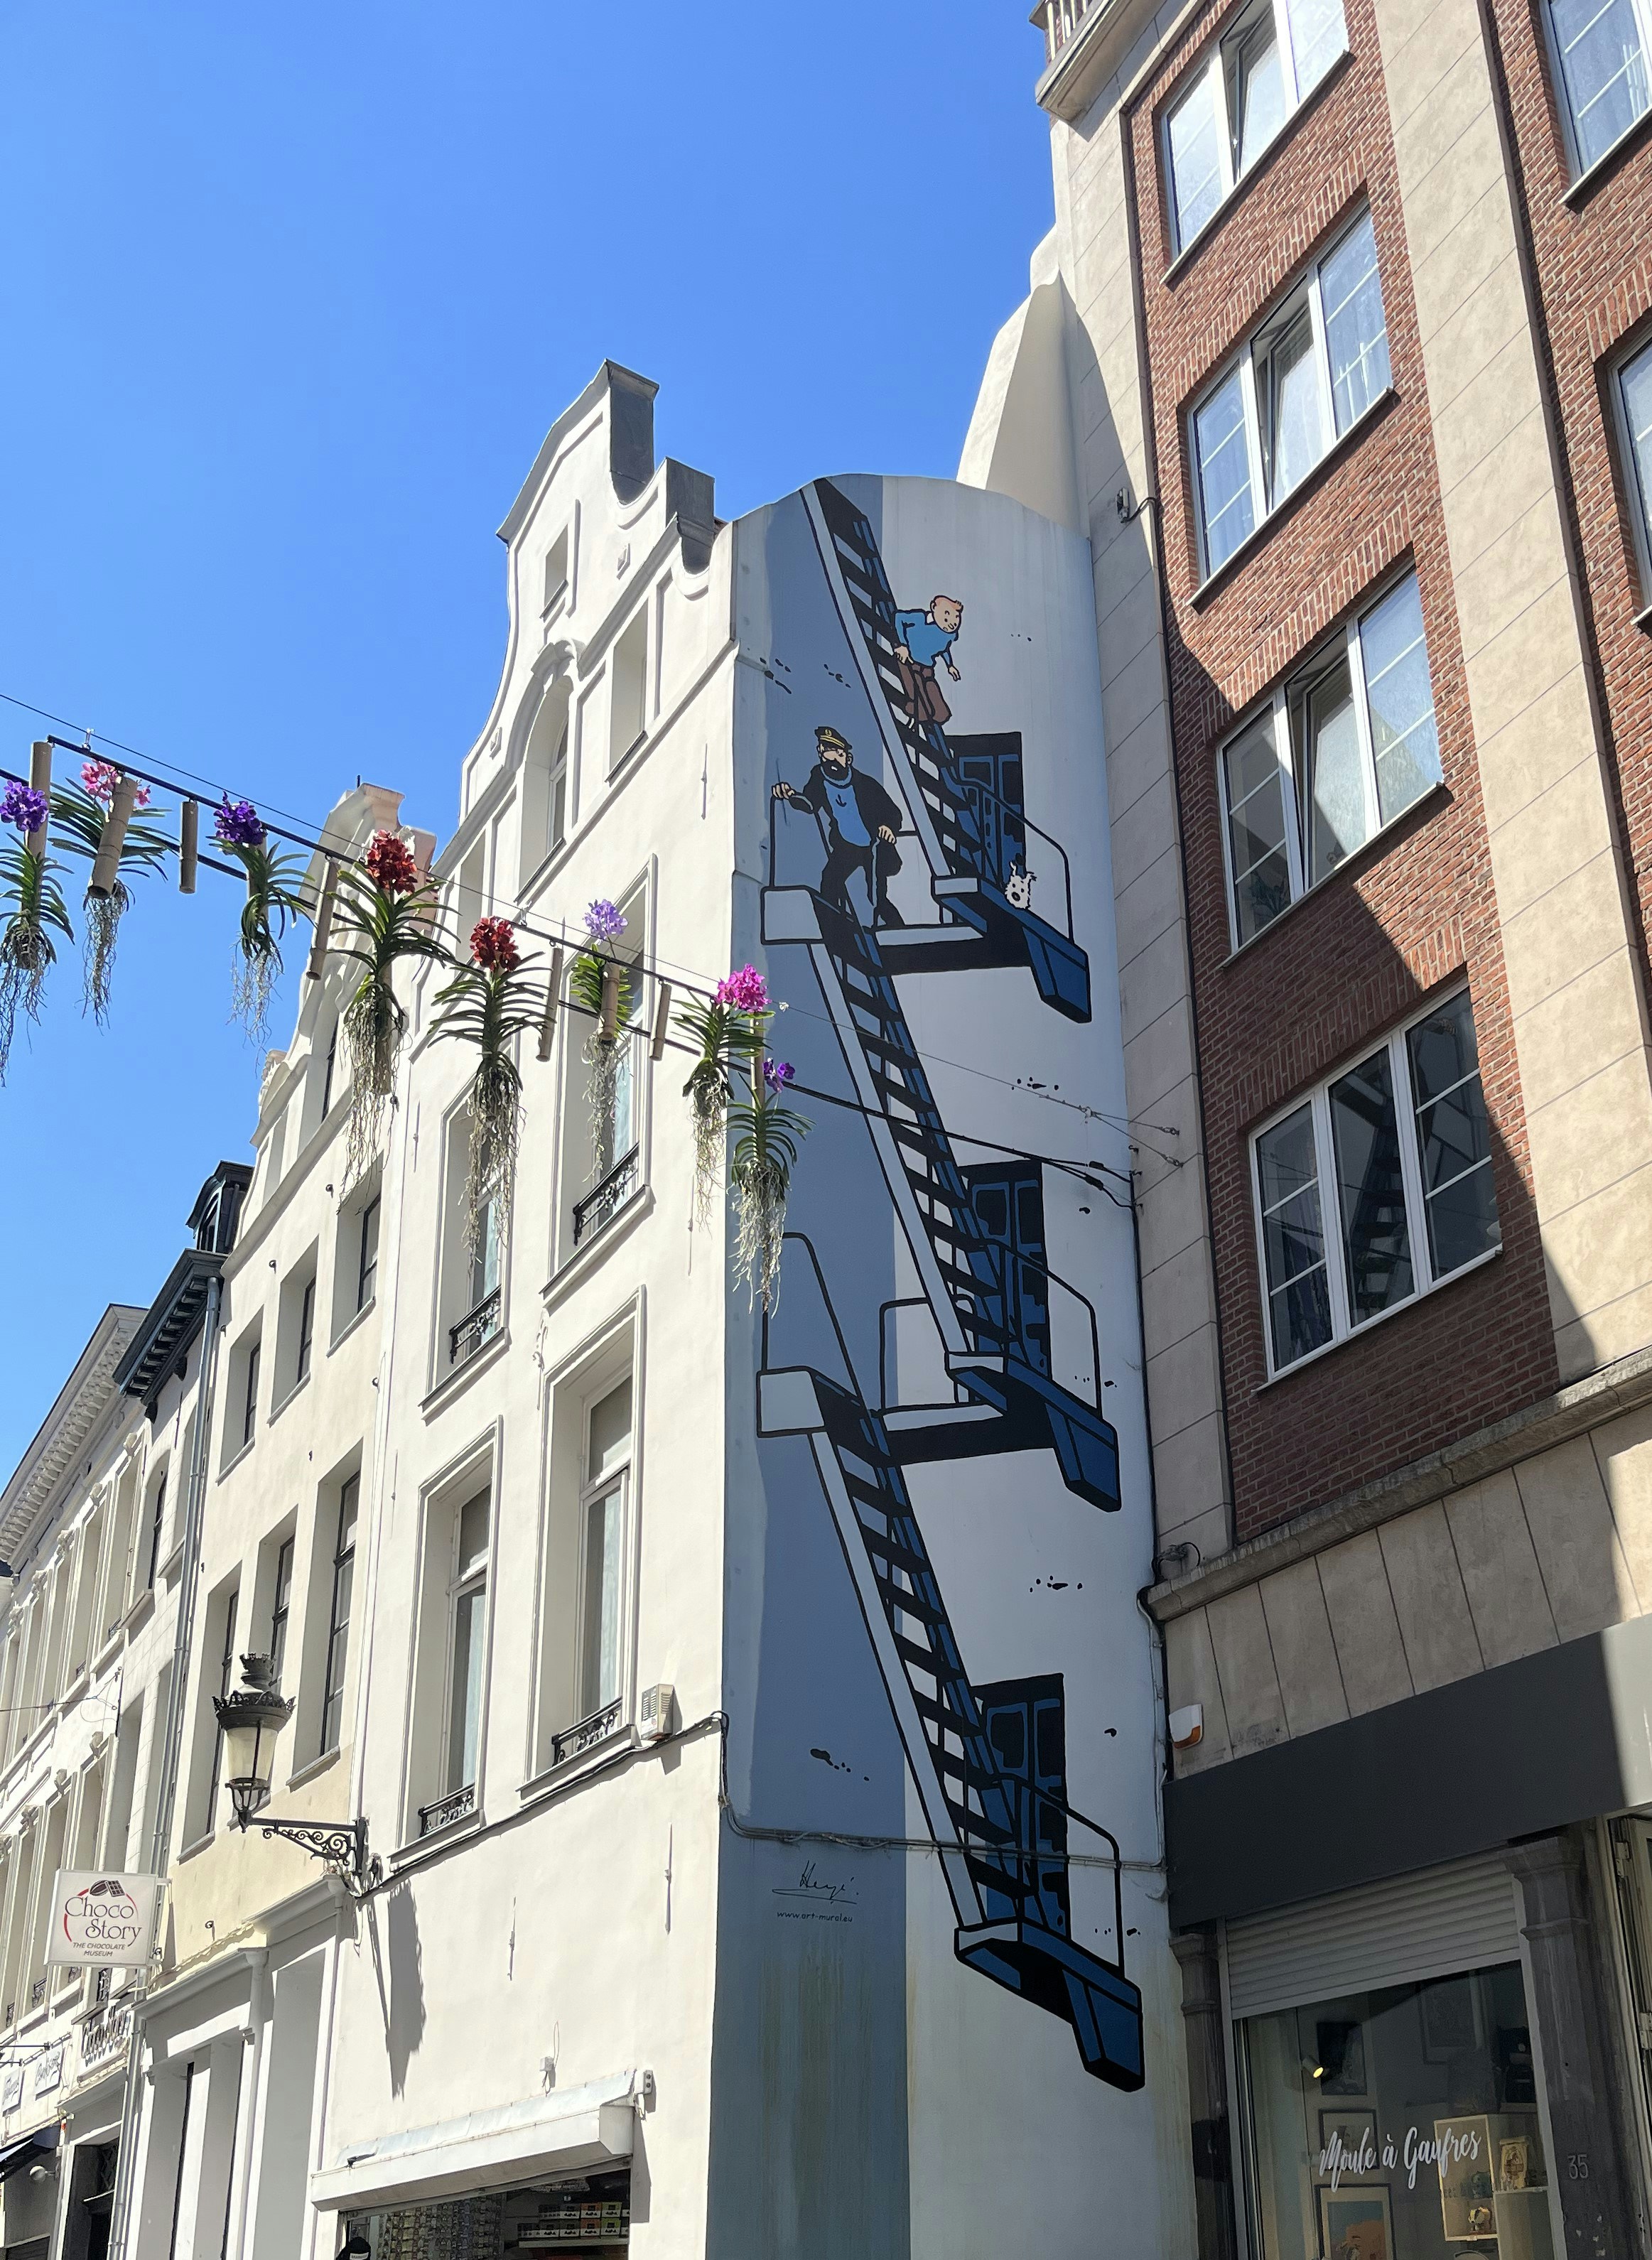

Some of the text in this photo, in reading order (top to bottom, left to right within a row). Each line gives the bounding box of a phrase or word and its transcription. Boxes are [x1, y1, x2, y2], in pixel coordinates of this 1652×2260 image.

[65, 1896, 134, 1918] Choco
[777, 1911, 853, 1923] www.art-mural.eu
[85, 1918, 142, 1947] Story
[1319, 2126, 1481, 2193] Moule à Gaufres
[1567, 2153, 1588, 2179] 35
